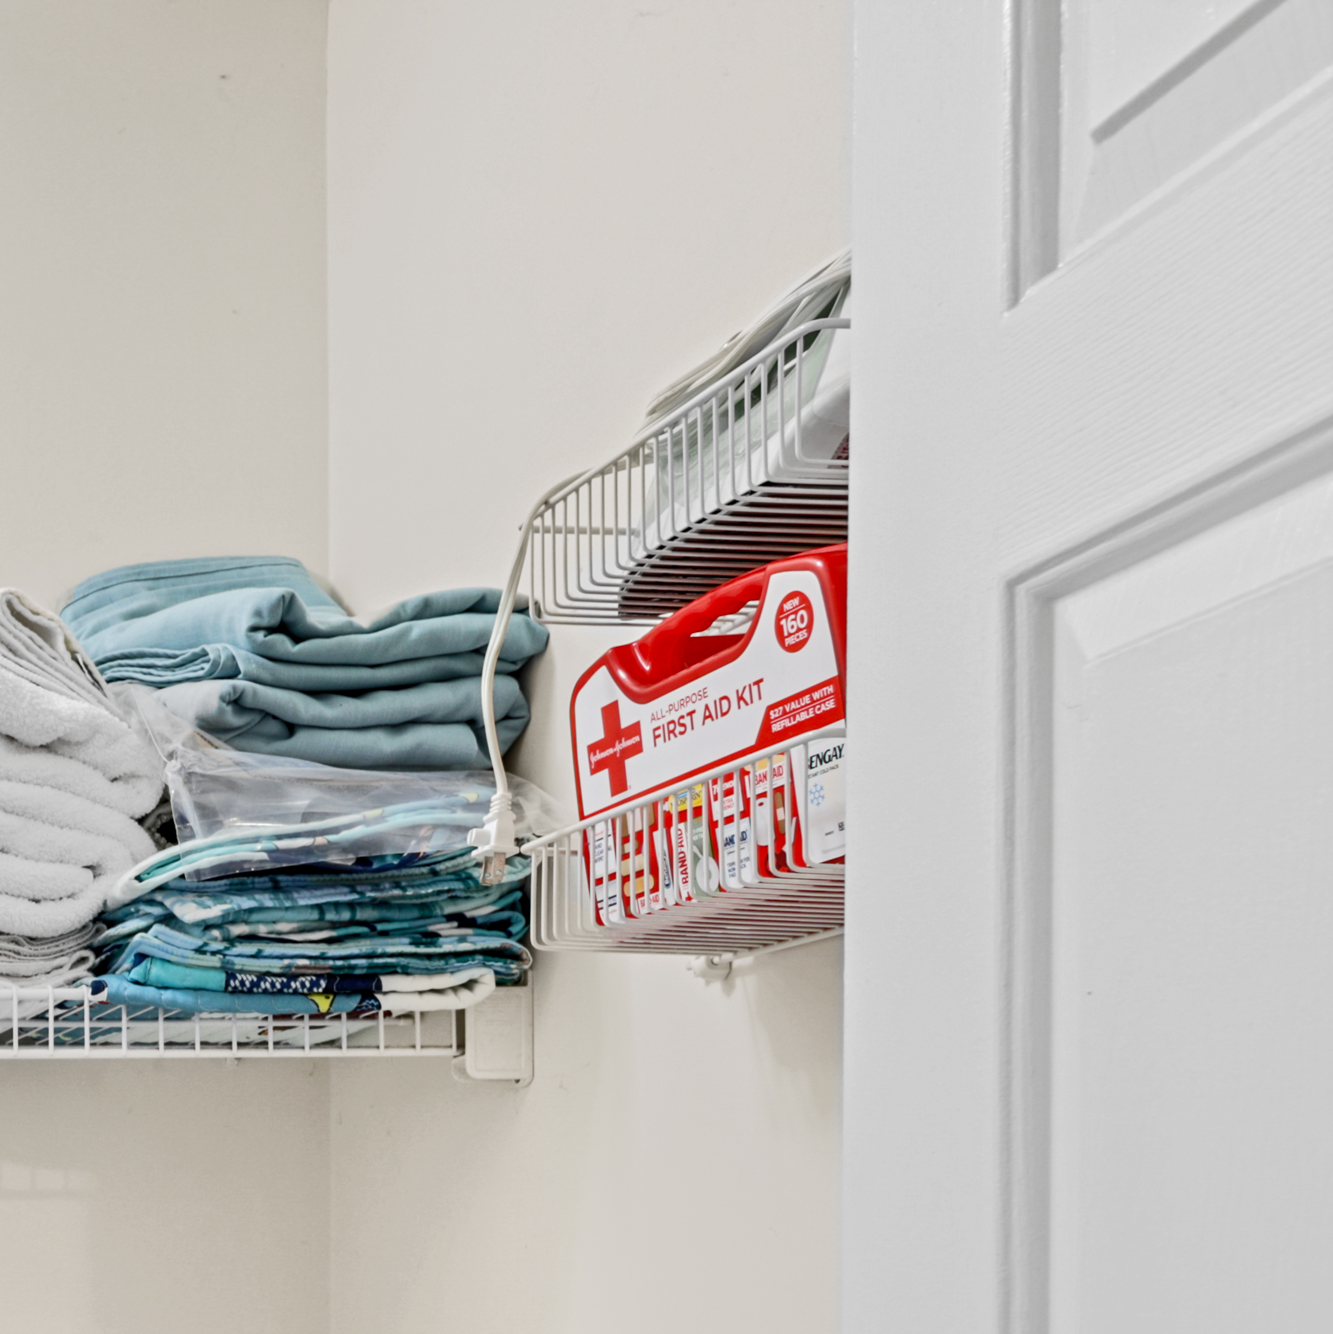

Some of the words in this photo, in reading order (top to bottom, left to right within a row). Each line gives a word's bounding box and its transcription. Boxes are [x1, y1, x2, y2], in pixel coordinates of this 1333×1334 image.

[783, 597, 800, 611] NEW
[780, 610, 808, 636] 160
[785, 629, 808, 647] PIECES
[650, 687, 709, 723] ALL-PURPOSE
[652, 710, 696, 747] FIRST
[702, 695, 731, 726] AID
[736, 678, 764, 710] KIT
[769, 707, 783, 719] $27
[784, 695, 811, 713] VALUE
[811, 685, 834, 700] WITH
[771, 707, 814, 733] REFILLABLE
[814, 699, 836, 714] CASE
[808, 743, 845, 770] ENGAY
